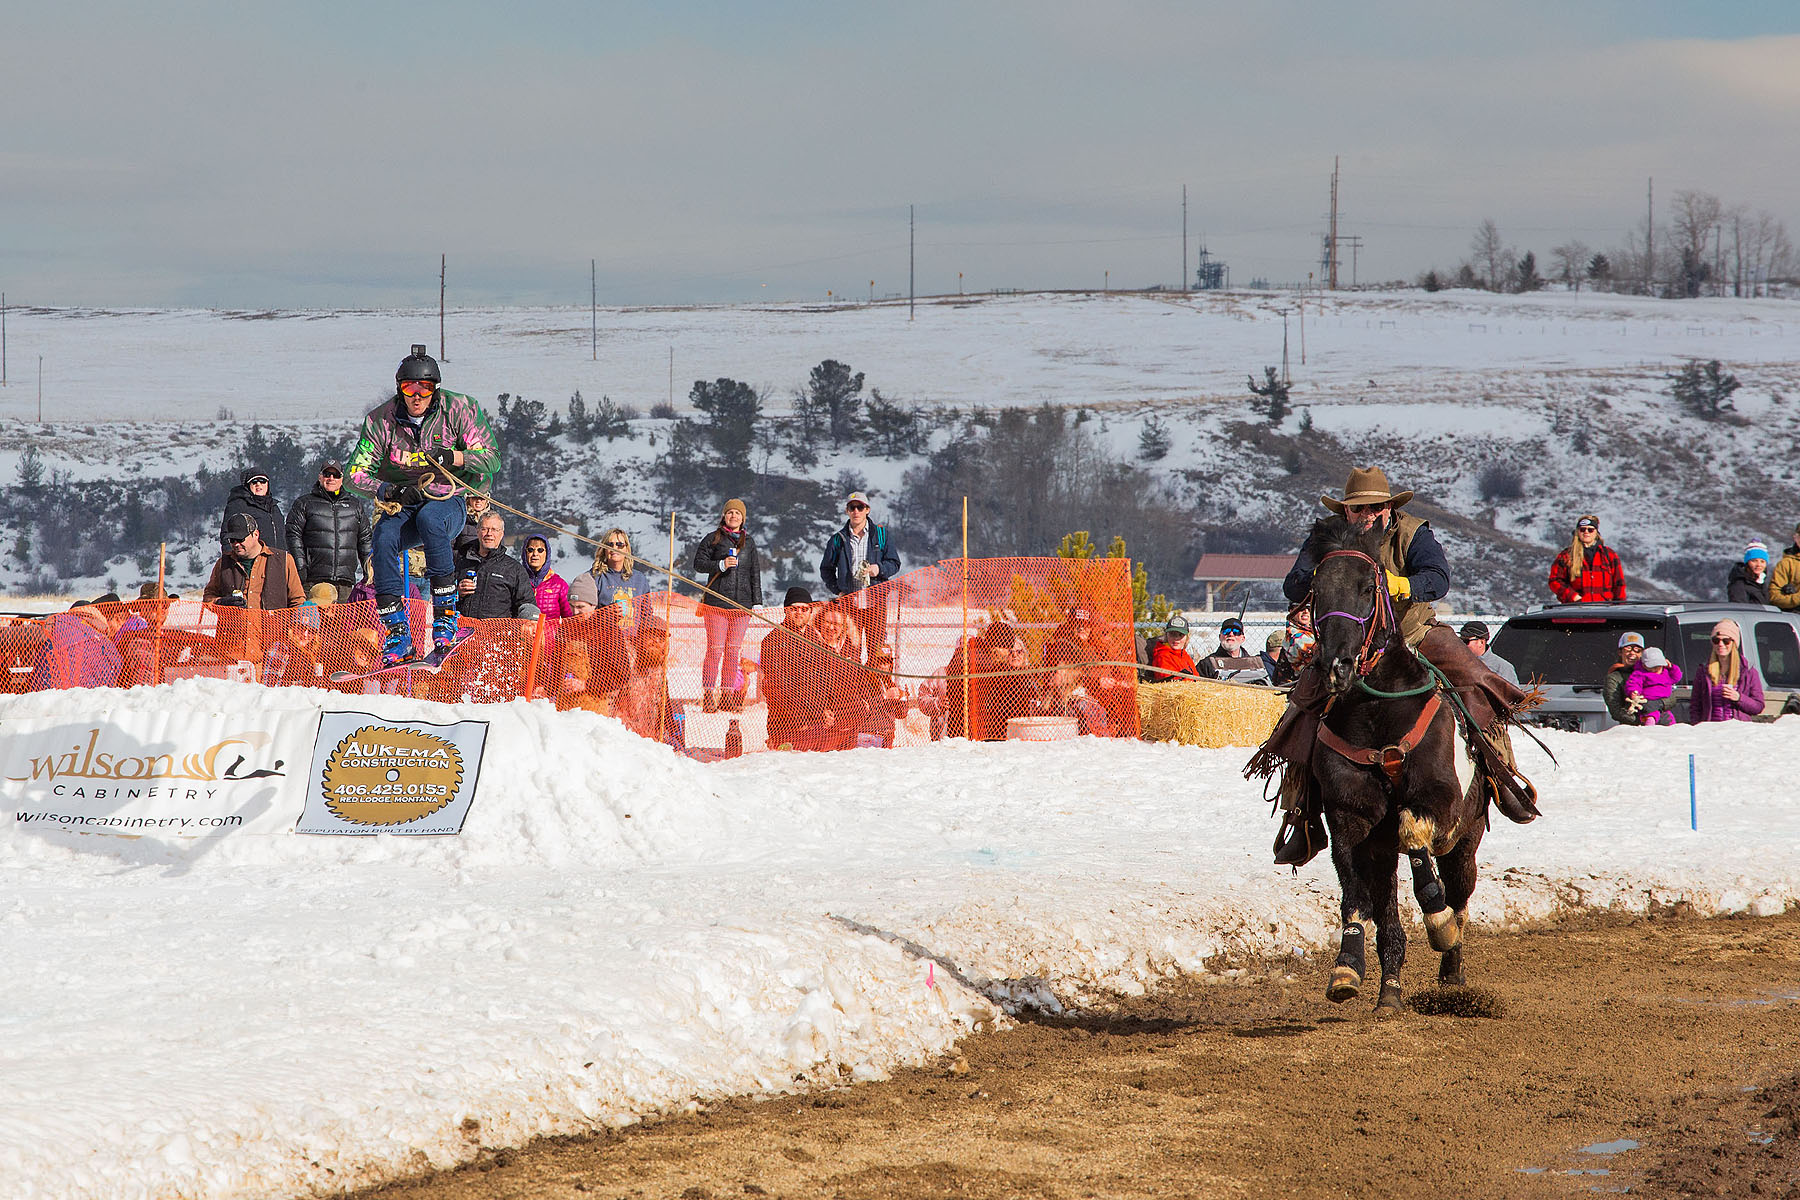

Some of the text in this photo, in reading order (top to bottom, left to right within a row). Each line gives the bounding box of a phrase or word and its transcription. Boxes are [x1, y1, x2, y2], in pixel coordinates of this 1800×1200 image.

[28, 728, 182, 781] wilson
[342, 741, 450, 759] AUKEMA
[340, 758, 450, 769] CONSTRUCTION
[53, 784, 218, 800] CABINETRY
[334, 784, 448, 796] 406.425.0153
[394, 795, 439, 803] MONTANA
[15, 811, 243, 827] wilsoncabinetry.com
